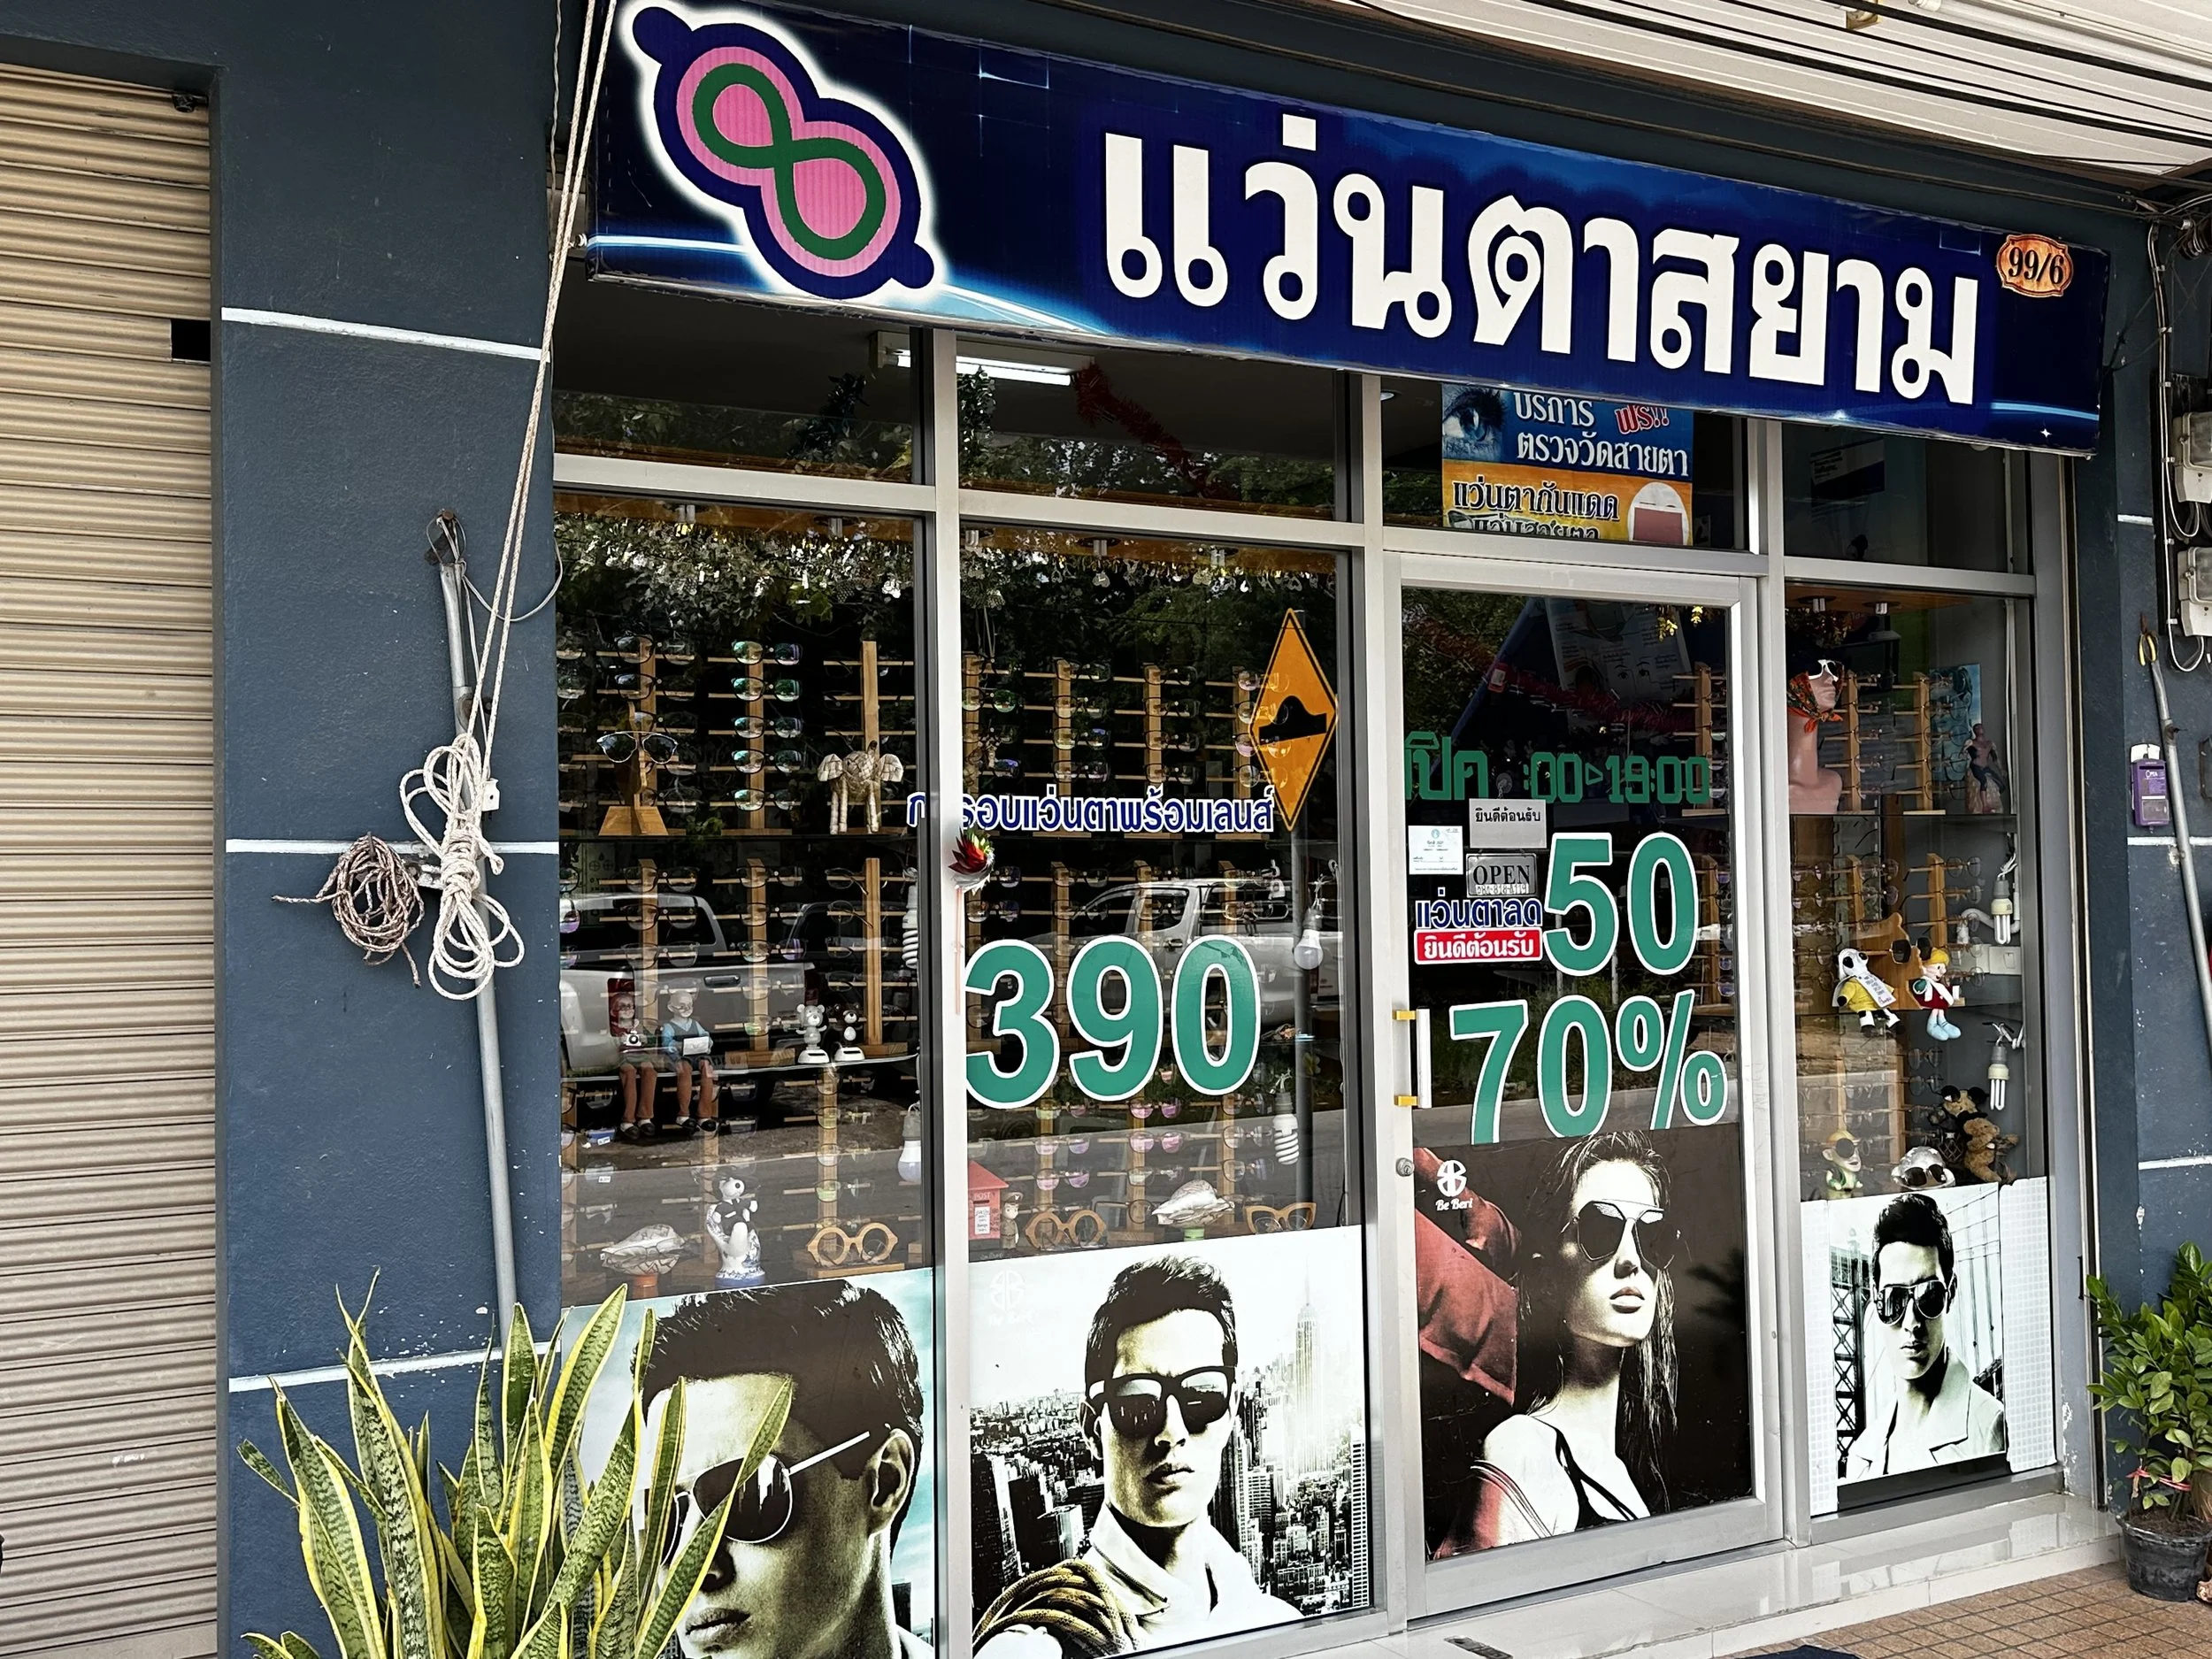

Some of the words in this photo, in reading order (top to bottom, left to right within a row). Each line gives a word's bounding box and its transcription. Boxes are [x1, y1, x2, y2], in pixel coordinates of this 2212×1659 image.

[1104, 115, 1978, 404] แว่นตาสยาม
[2008, 246, 2064, 284] 99/6
[1514, 392, 1595, 426] บรการ
[1517, 431, 1689, 477] ตรวจวัดสายตา
[1452, 475, 1620, 521] แว่นตากันแดด
[1475, 806, 1541, 823] ยินดีต้อนรับ
[1473, 864, 1530, 886] OPEN
[1416, 887, 1543, 929] แว่นตาลด
[1544, 832, 1699, 976] 50
[1424, 931, 1534, 959] ยินดีต้อนรับ
[965, 934, 1262, 1110] 390
[1449, 989, 1728, 1145] 70%
